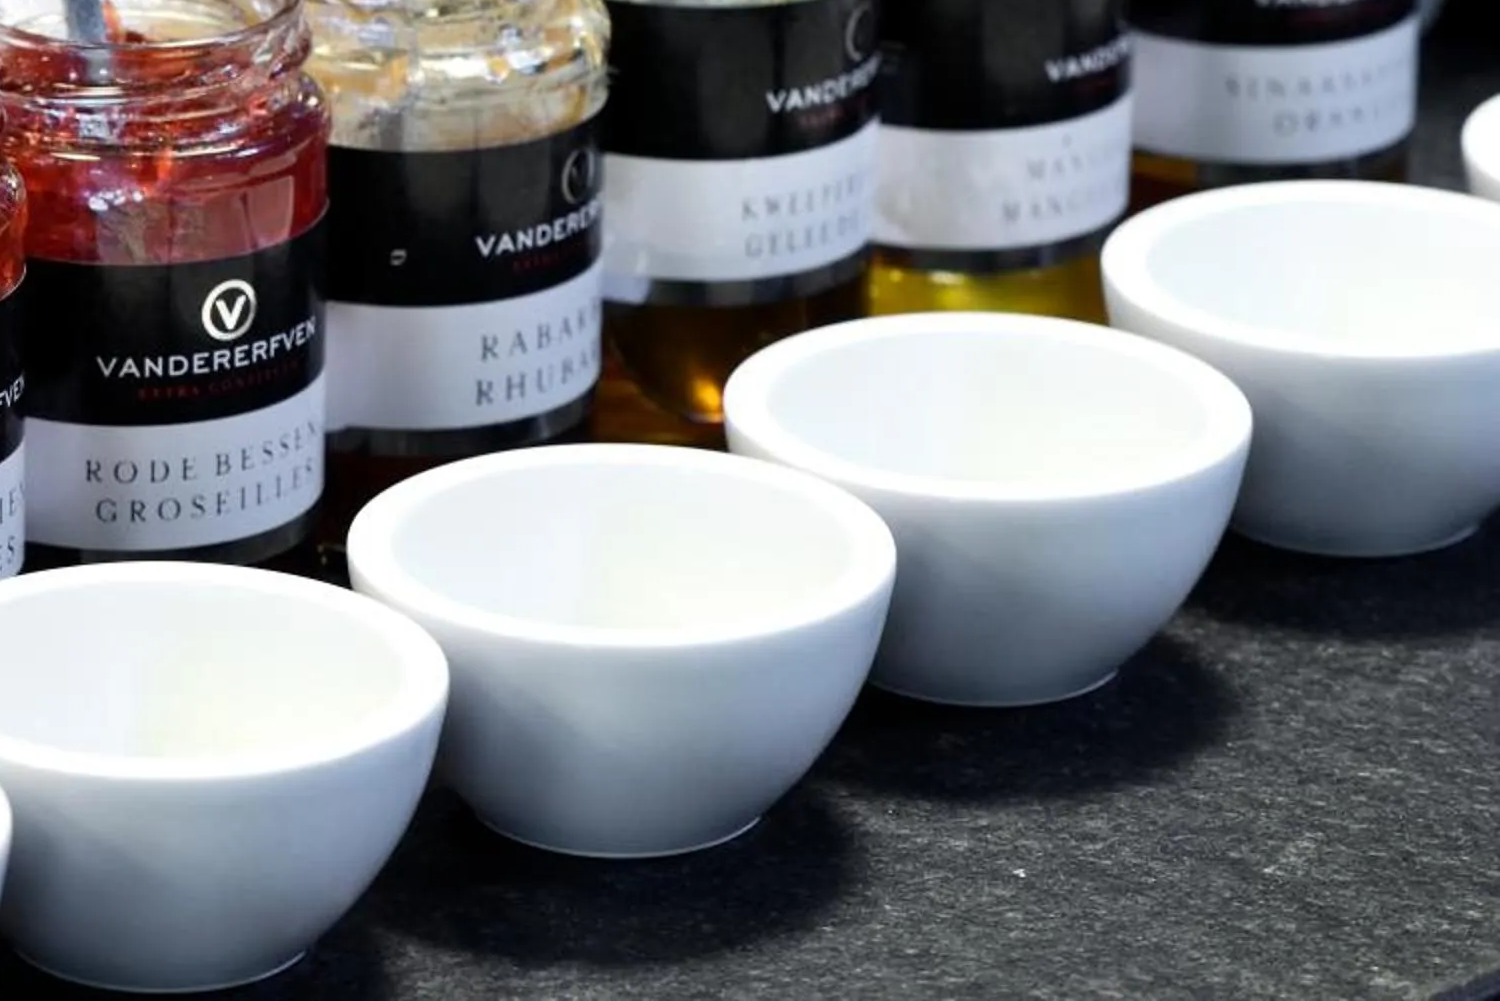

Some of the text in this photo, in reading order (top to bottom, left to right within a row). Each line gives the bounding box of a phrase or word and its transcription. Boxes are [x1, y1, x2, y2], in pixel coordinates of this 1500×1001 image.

[96, 315, 317, 378] VANDERERFVEN
[85, 419, 318, 485] RODE BESSEN
[95, 456, 313, 524] GROSEILLES
